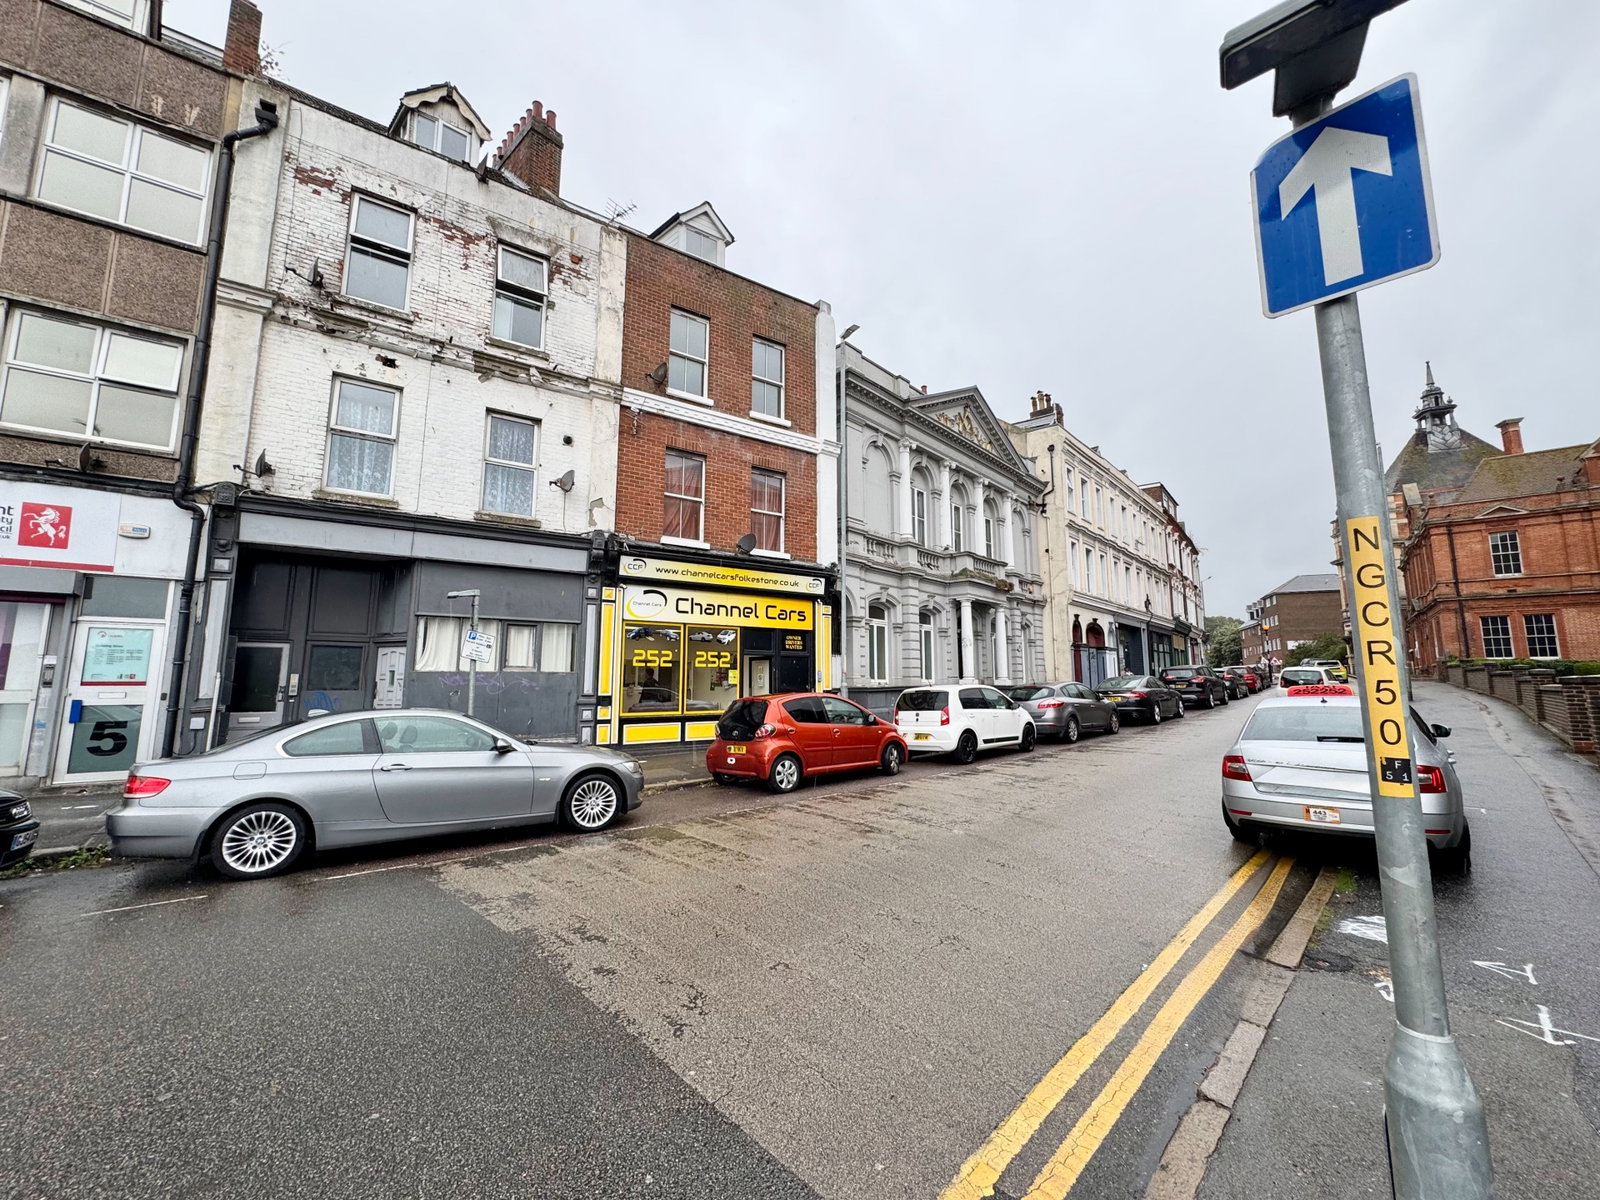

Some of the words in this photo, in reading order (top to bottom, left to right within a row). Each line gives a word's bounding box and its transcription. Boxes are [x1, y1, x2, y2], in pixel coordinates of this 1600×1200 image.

[676, 597, 759, 618] Channel
[765, 605, 807, 622] Cars
[632, 649, 673, 667] 252
[695, 651, 731, 668] 252
[86, 720, 129, 756] 5
[1395, 760, 1402, 769] F
